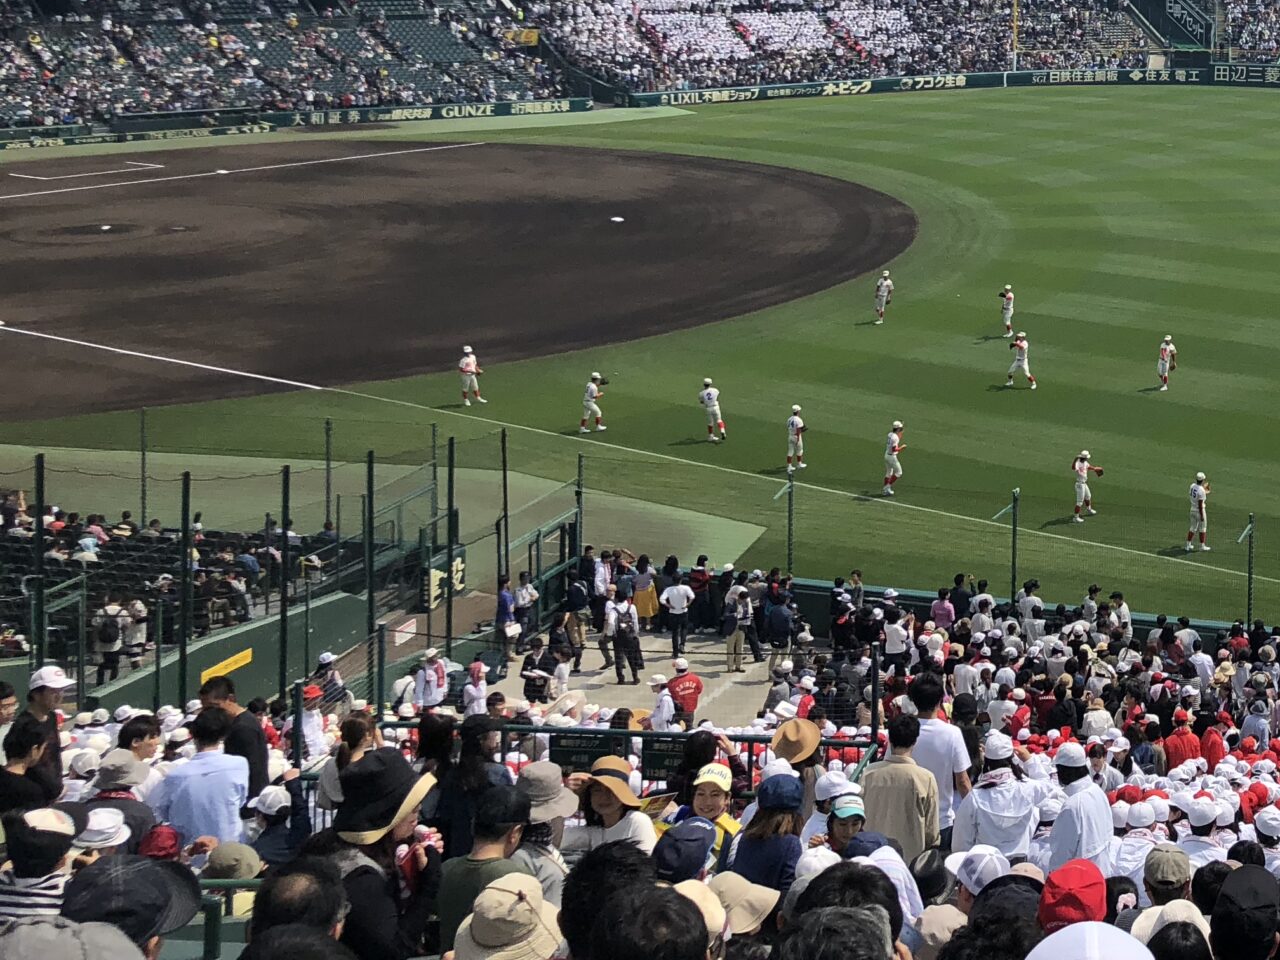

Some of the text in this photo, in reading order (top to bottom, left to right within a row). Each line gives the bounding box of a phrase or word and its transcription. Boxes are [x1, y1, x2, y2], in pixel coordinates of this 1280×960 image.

[914, 76, 967, 89] フコク生命
[1050, 70, 1118, 83] 日鉄住金鋼板
[1145, 70, 1200, 82] 住友電工
[823, 81, 872, 96] オービック
[441, 104, 495, 118] GUNZE
[293, 110, 361, 127] 大和証券
